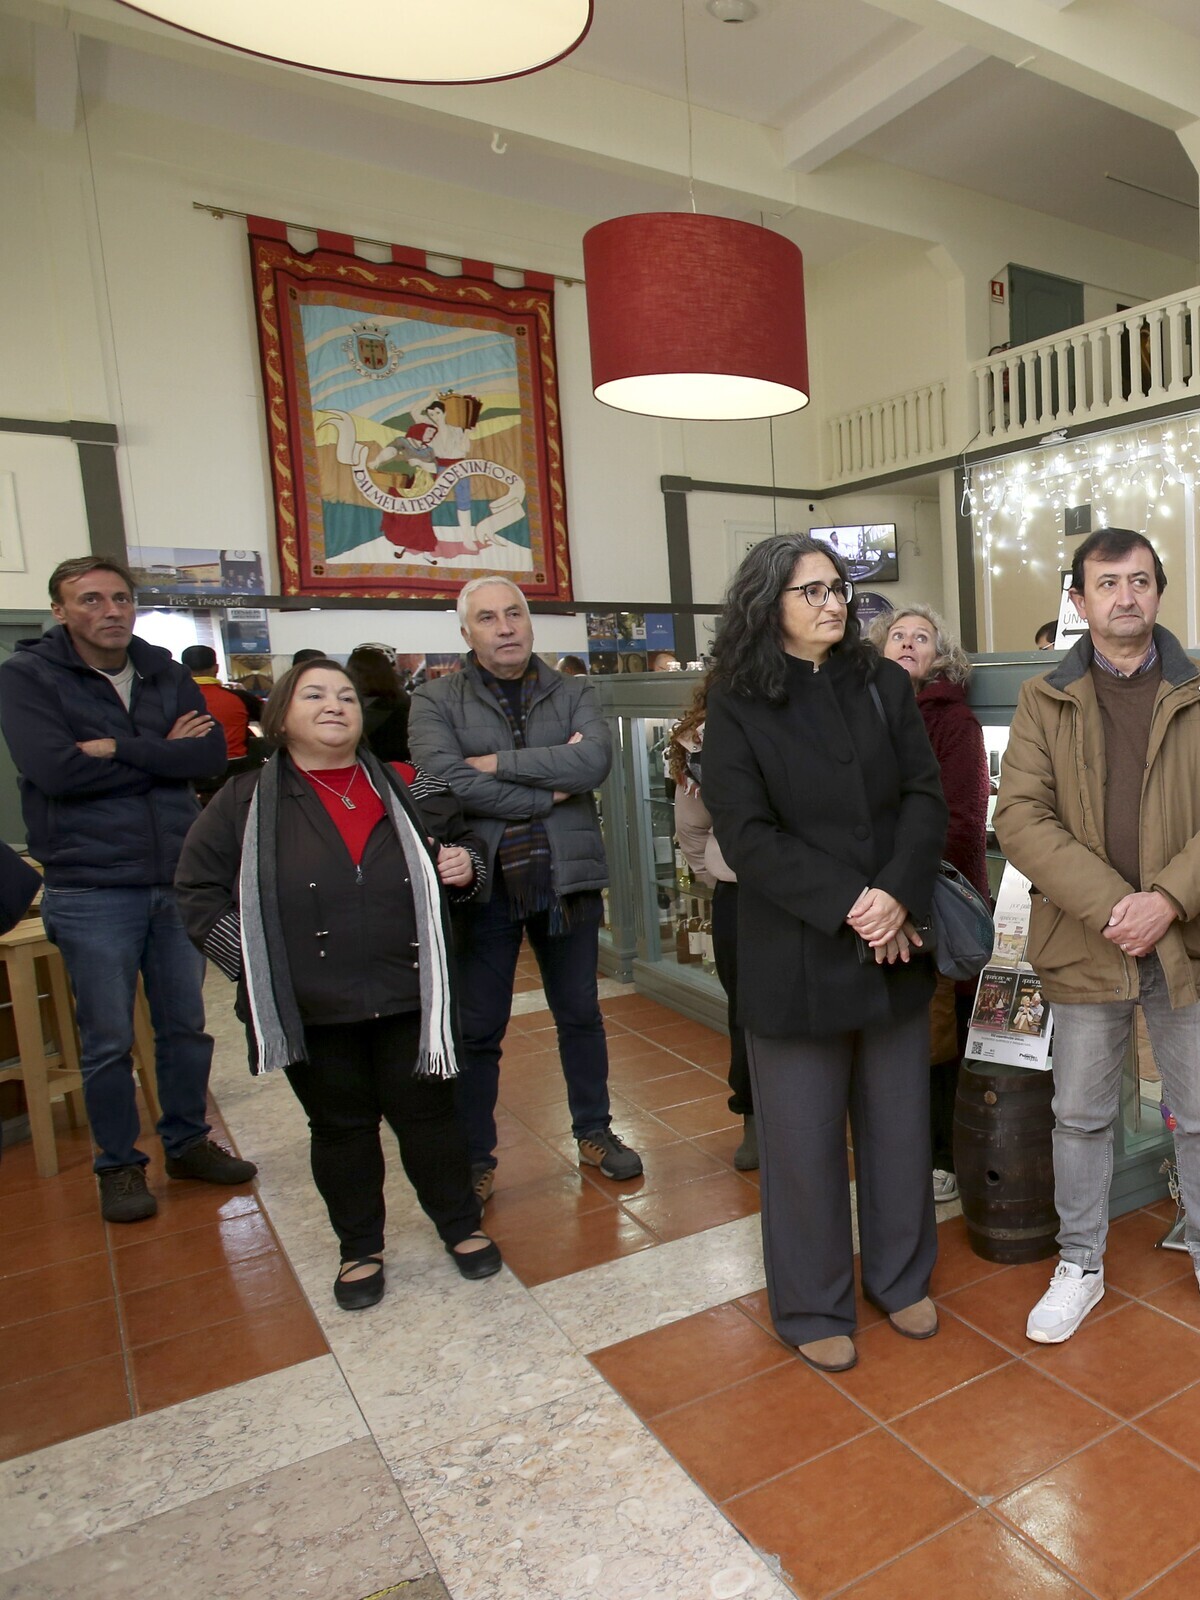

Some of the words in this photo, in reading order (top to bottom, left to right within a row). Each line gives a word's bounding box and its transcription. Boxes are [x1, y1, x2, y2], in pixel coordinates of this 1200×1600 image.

[354, 469, 407, 512] PALMELA
[408, 484, 449, 512] TERRA
[447, 467, 462, 485] DE
[459, 460, 518, 486] VINHOS
[1074, 510, 1082, 530] 1
